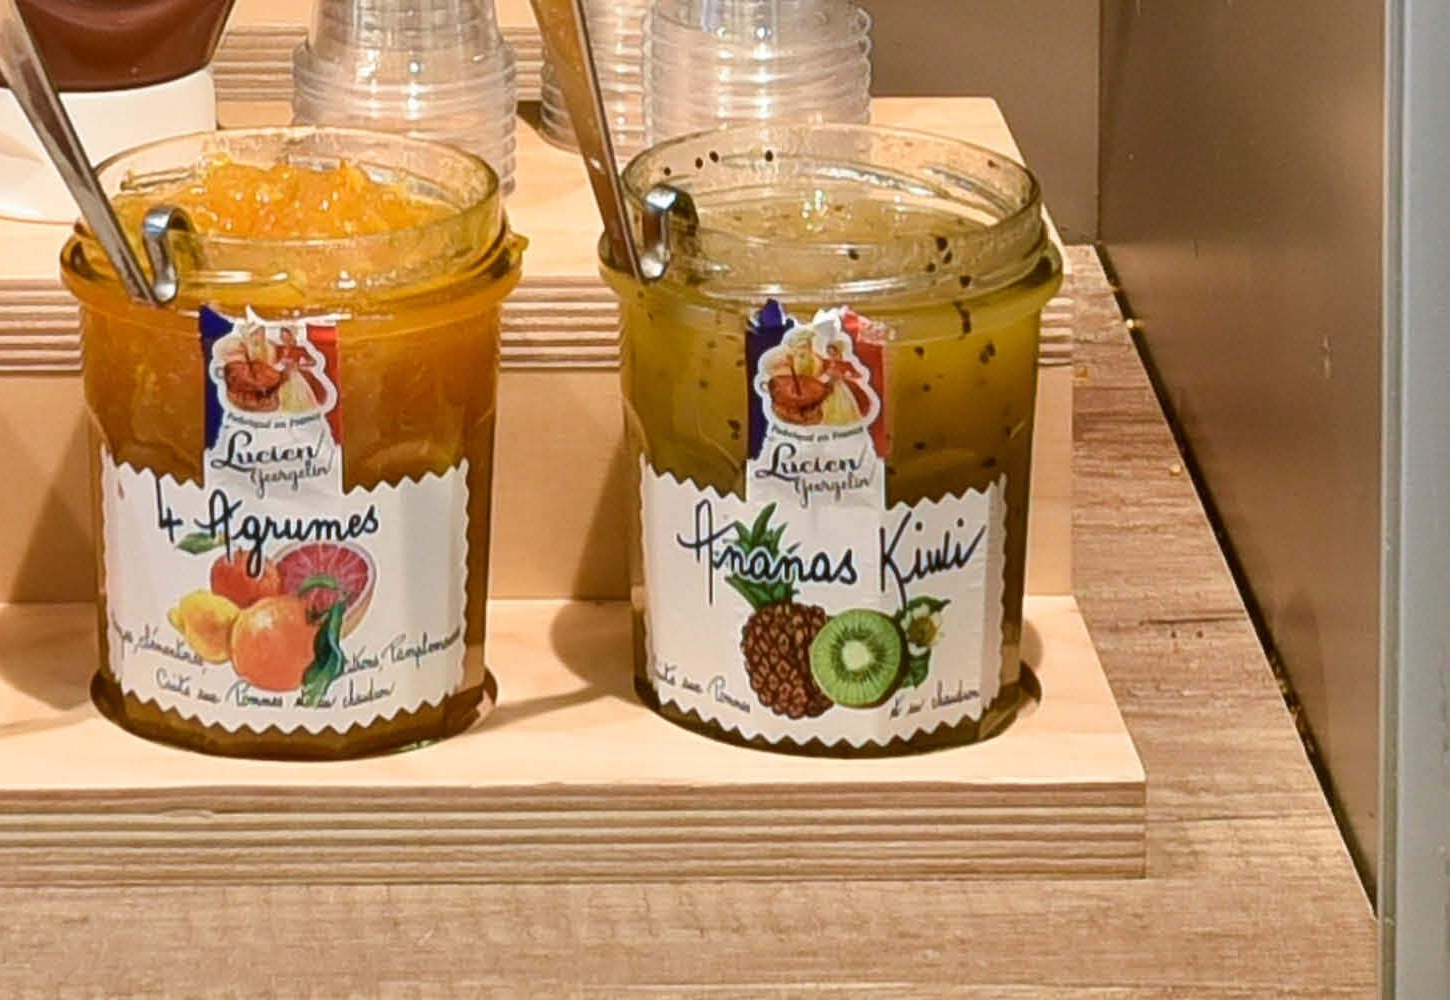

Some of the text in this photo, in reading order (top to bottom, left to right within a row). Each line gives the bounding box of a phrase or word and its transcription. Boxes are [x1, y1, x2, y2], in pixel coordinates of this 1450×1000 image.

[210, 429, 326, 473] Lucien
[754, 442, 868, 482] Lucien
[153, 468, 379, 578] 4 Agrumes
[676, 498, 987, 616] Ananas Kiwi
